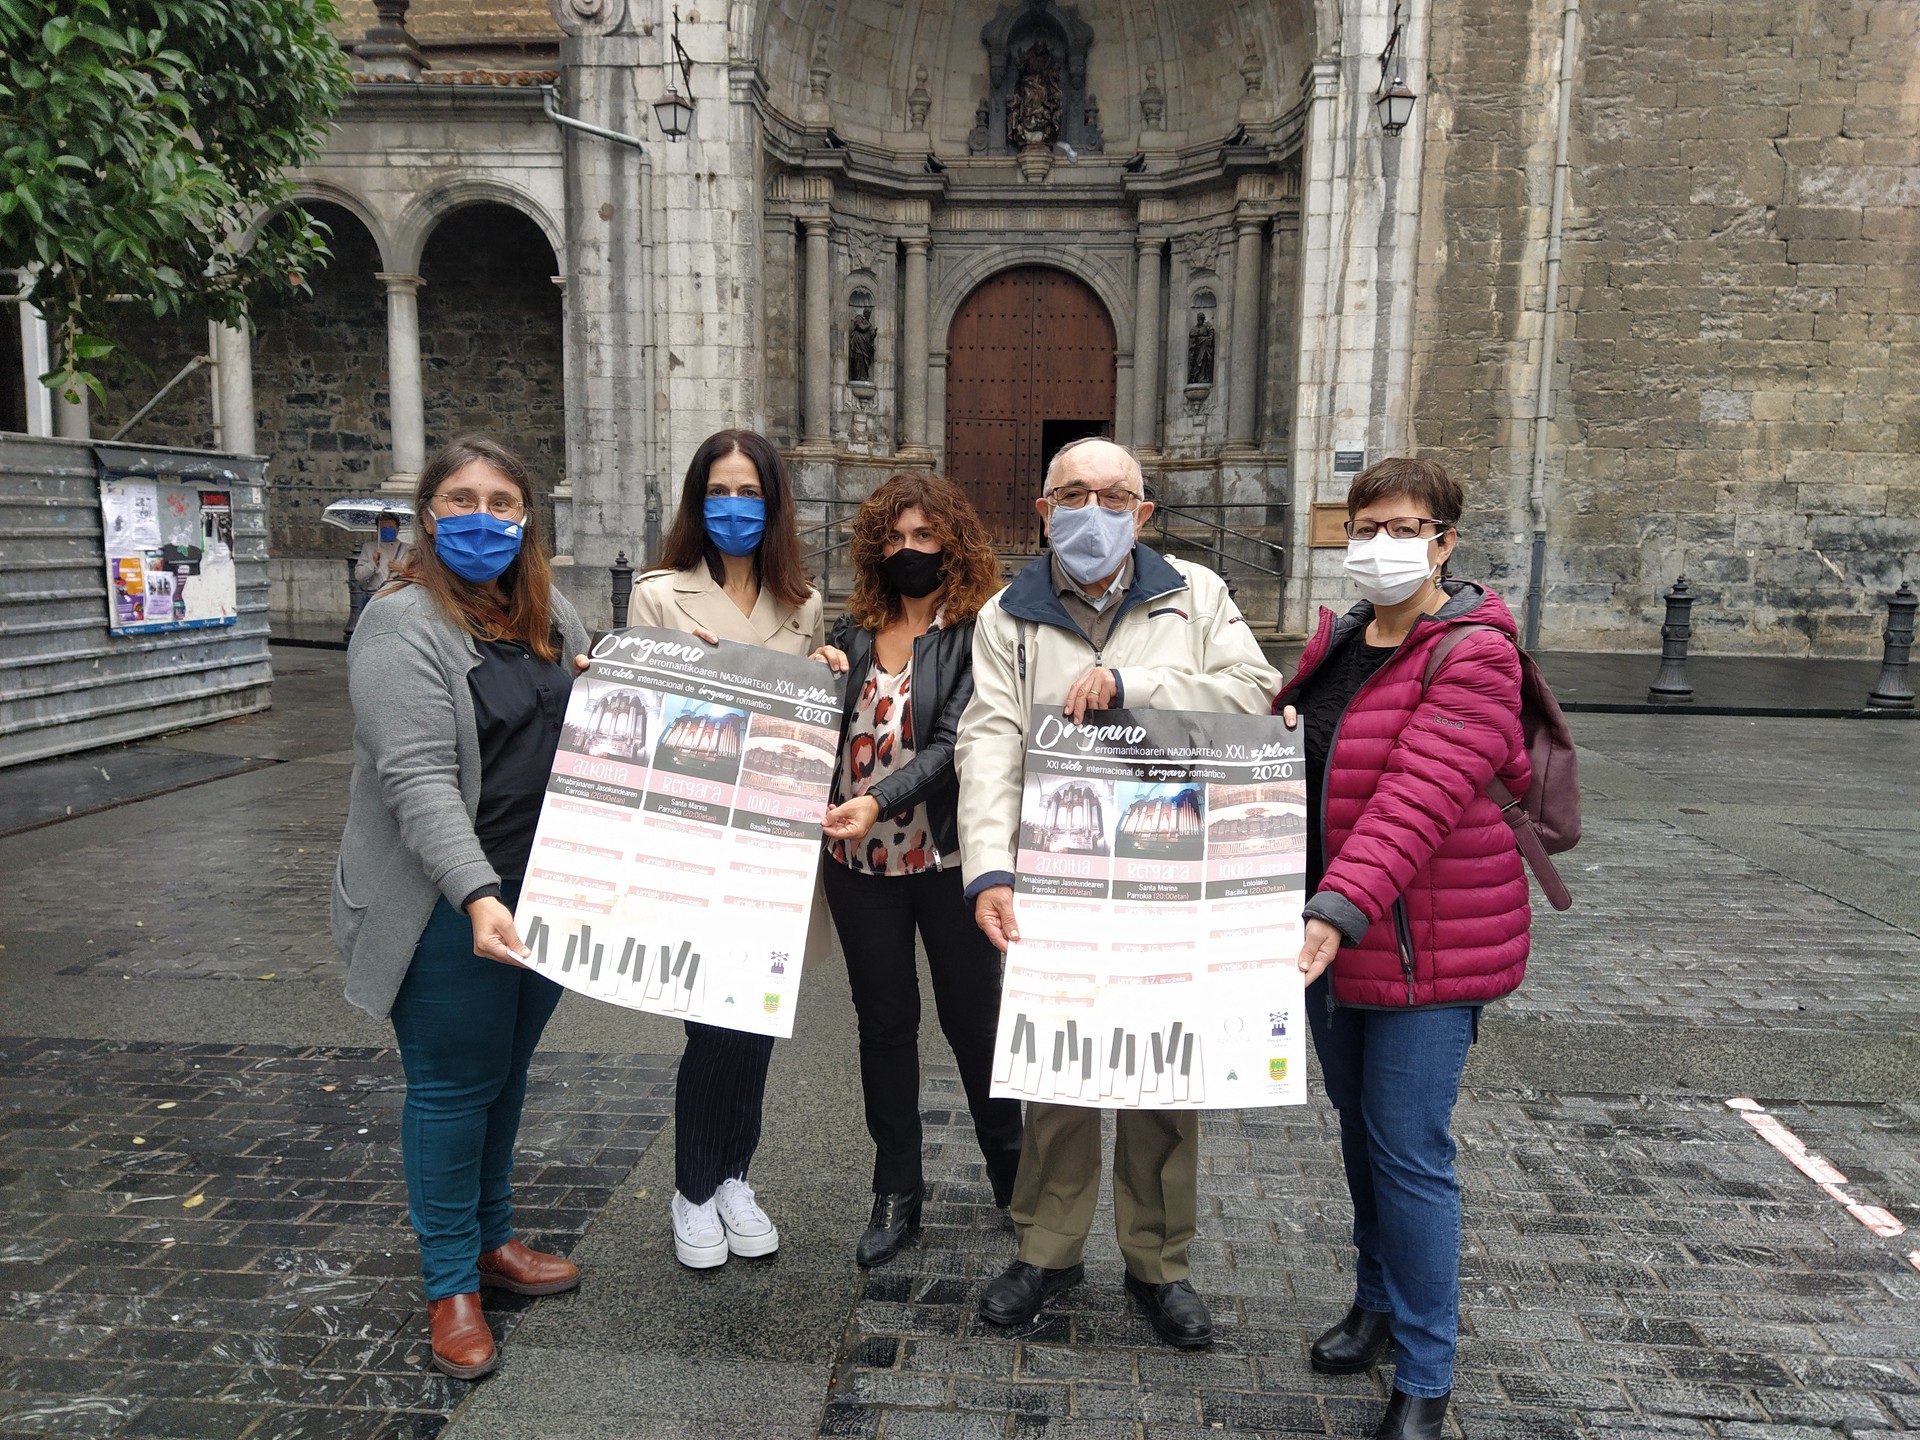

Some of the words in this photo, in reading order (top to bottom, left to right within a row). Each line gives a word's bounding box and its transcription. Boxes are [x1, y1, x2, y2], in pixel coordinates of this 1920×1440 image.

[597, 666, 611, 676] XXI
[612, 667, 634, 680] ciclo
[637, 673, 683, 690] internacional
[685, 684, 695, 693] de
[698, 684, 734, 701] órgano
[736, 695, 772, 710] romántico
[649, 658, 717, 678] erromantikoaren
[719, 671, 772, 691] NAZIOARTEKO
[775, 679, 796, 697] XXI.
[797, 685, 838, 705] zikloa
[794, 705, 832, 725] 2020
[1095, 745, 1164, 756] erromantikoaren
[1167, 747, 1222, 758] NAZIOARTEKO
[1225, 743, 1249, 760] XXI.
[1250, 742, 1296, 761] zikloa
[1046, 759, 1059, 769] XXI
[1061, 760, 1083, 772] ciclo
[1086, 763, 1133, 776] internacional
[1135, 768, 1145, 777] de
[1148, 765, 1187, 782] órgano
[1188, 768, 1226, 779] romántico
[1251, 763, 1293, 780] 2020
[555, 775, 595, 789] Amabirjinaren
[595, 783, 638, 798] Jasokundearen
[564, 786, 590, 797] Parrokia
[590, 791, 626, 804] (20:00etan)
[670, 798, 687, 808] Santa
[688, 801, 708, 812] Marina
[657, 804, 682, 816] Parrokia
[682, 810, 717, 822] (20:00etan)
[749, 822, 771, 833] Basilika
[766, 818, 790, 828] Loiolako
[1021, 875, 1060, 886] Amabirjinaren
[1061, 879, 1104, 889] Jasokundearen
[1138, 884, 1156, 892] Santa
[1157, 884, 1178, 892] Marina
[1242, 879, 1269, 887] Loiolako
[1031, 885, 1056, 894] Parrokia
[1057, 887, 1093, 897] (20:00etan)
[1126, 891, 1152, 900] Parrokia
[1153, 892, 1190, 901] (20:00etan)
[1225, 888, 1249, 897] Basilika
